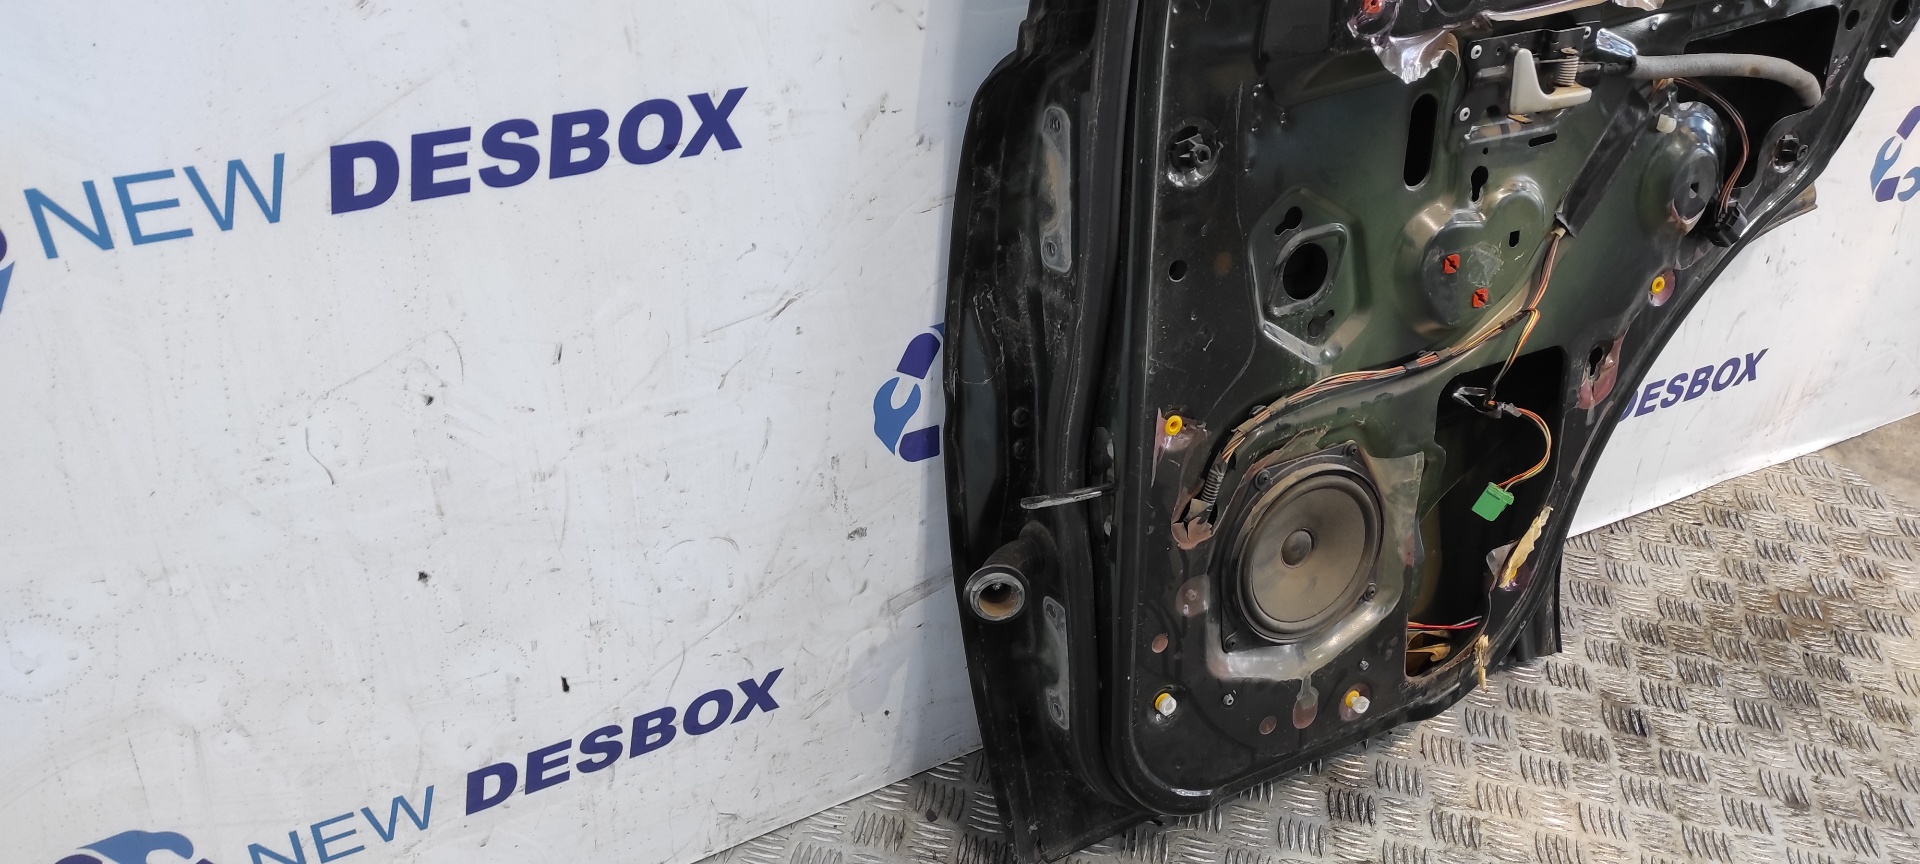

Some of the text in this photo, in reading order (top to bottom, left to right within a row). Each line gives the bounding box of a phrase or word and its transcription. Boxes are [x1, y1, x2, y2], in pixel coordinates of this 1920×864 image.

[24, 87, 749, 260] NEW DESBOX
[247, 668, 784, 864] NEW DESBOX
